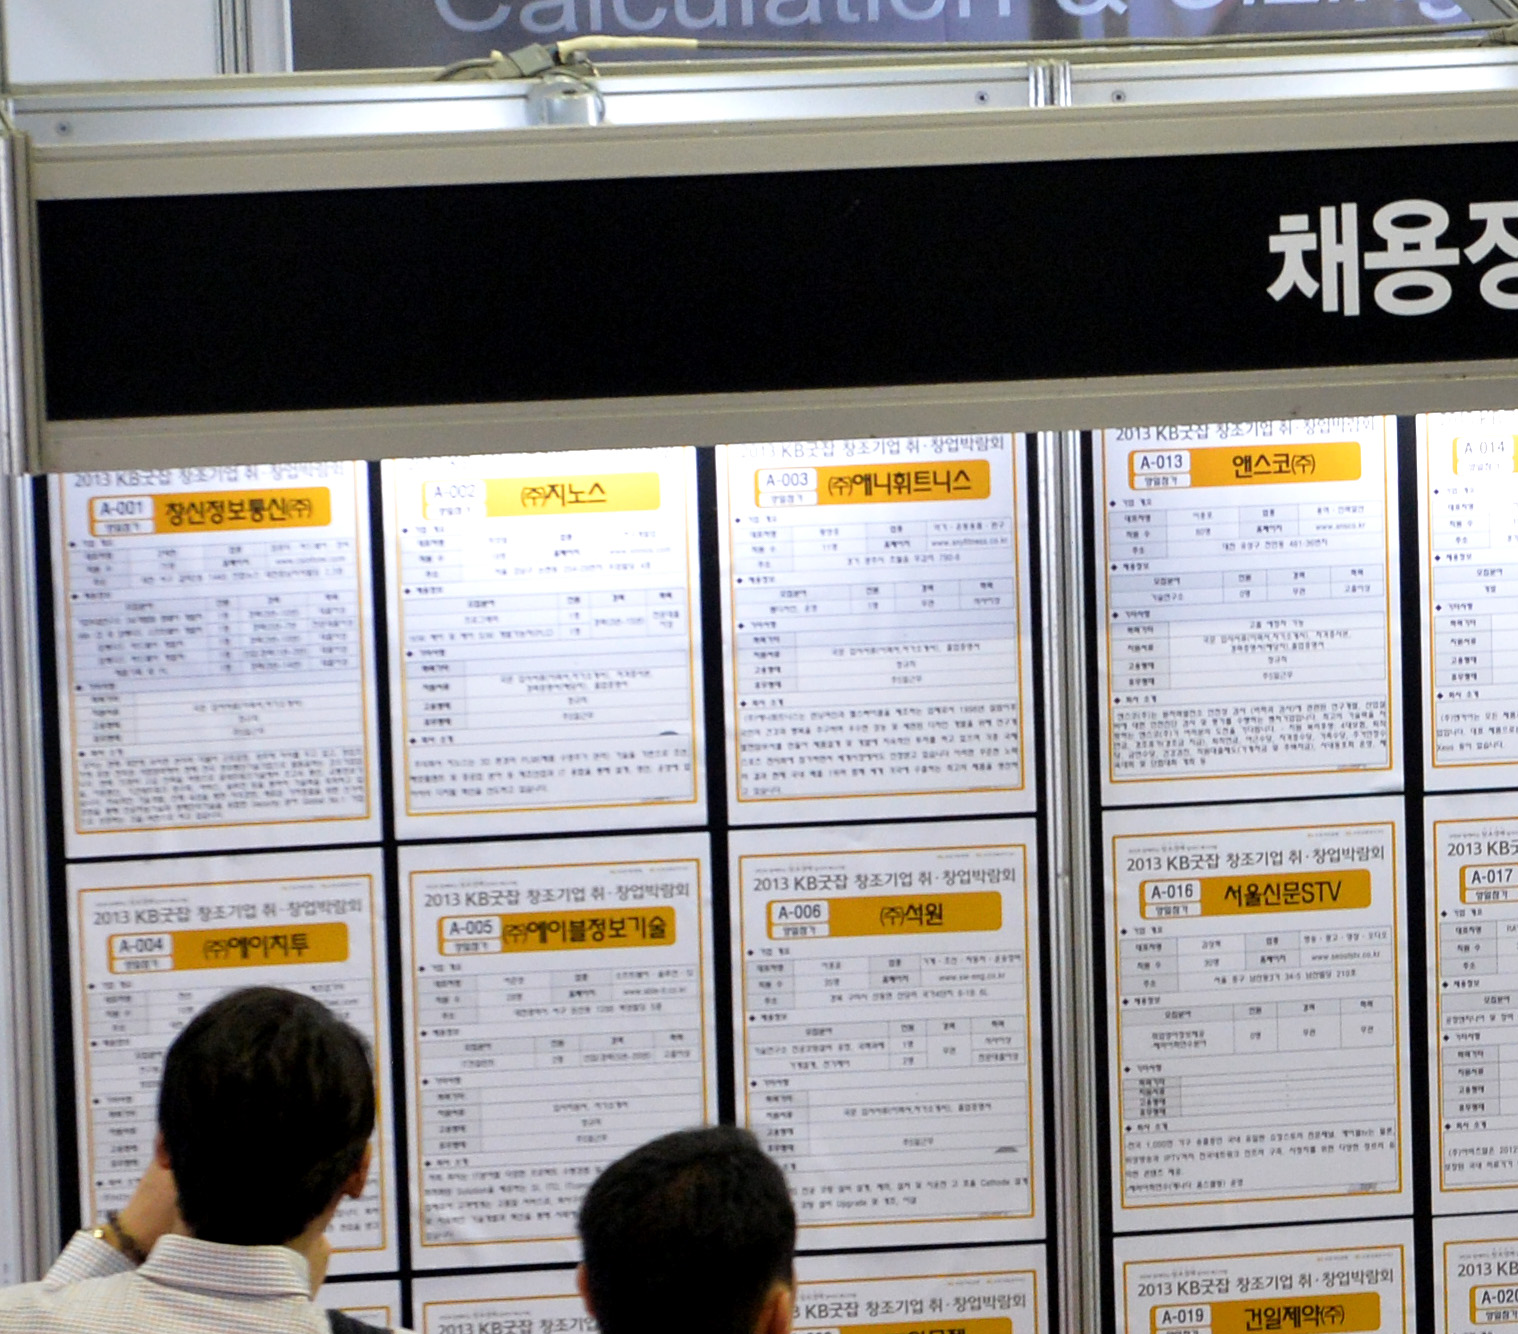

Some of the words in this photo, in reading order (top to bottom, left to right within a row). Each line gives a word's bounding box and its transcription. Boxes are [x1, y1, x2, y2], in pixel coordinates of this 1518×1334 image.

[1140, 454, 1183, 470] A-013
[766, 472, 809, 487] A-003
[100, 501, 143, 516] A-001
[1447, 841, 1483, 857] 2013
[1126, 856, 1162, 872] 2013
[1226, 850, 1283, 870] 창조기업
[754, 876, 790, 892] 2013
[854, 871, 913, 890] 창조기업
[1471, 868, 1513, 885] A-017
[1151, 883, 1194, 900] A-016
[1224, 880, 1342, 908] 서울신문STV
[95, 910, 131, 926] 2013
[778, 903, 822, 920] A-006
[449, 919, 493, 936] A-005
[119, 937, 164, 953] A-004
[1457, 1262, 1493, 1278] 2013
[1162, 1309, 1204, 1325] A-019
